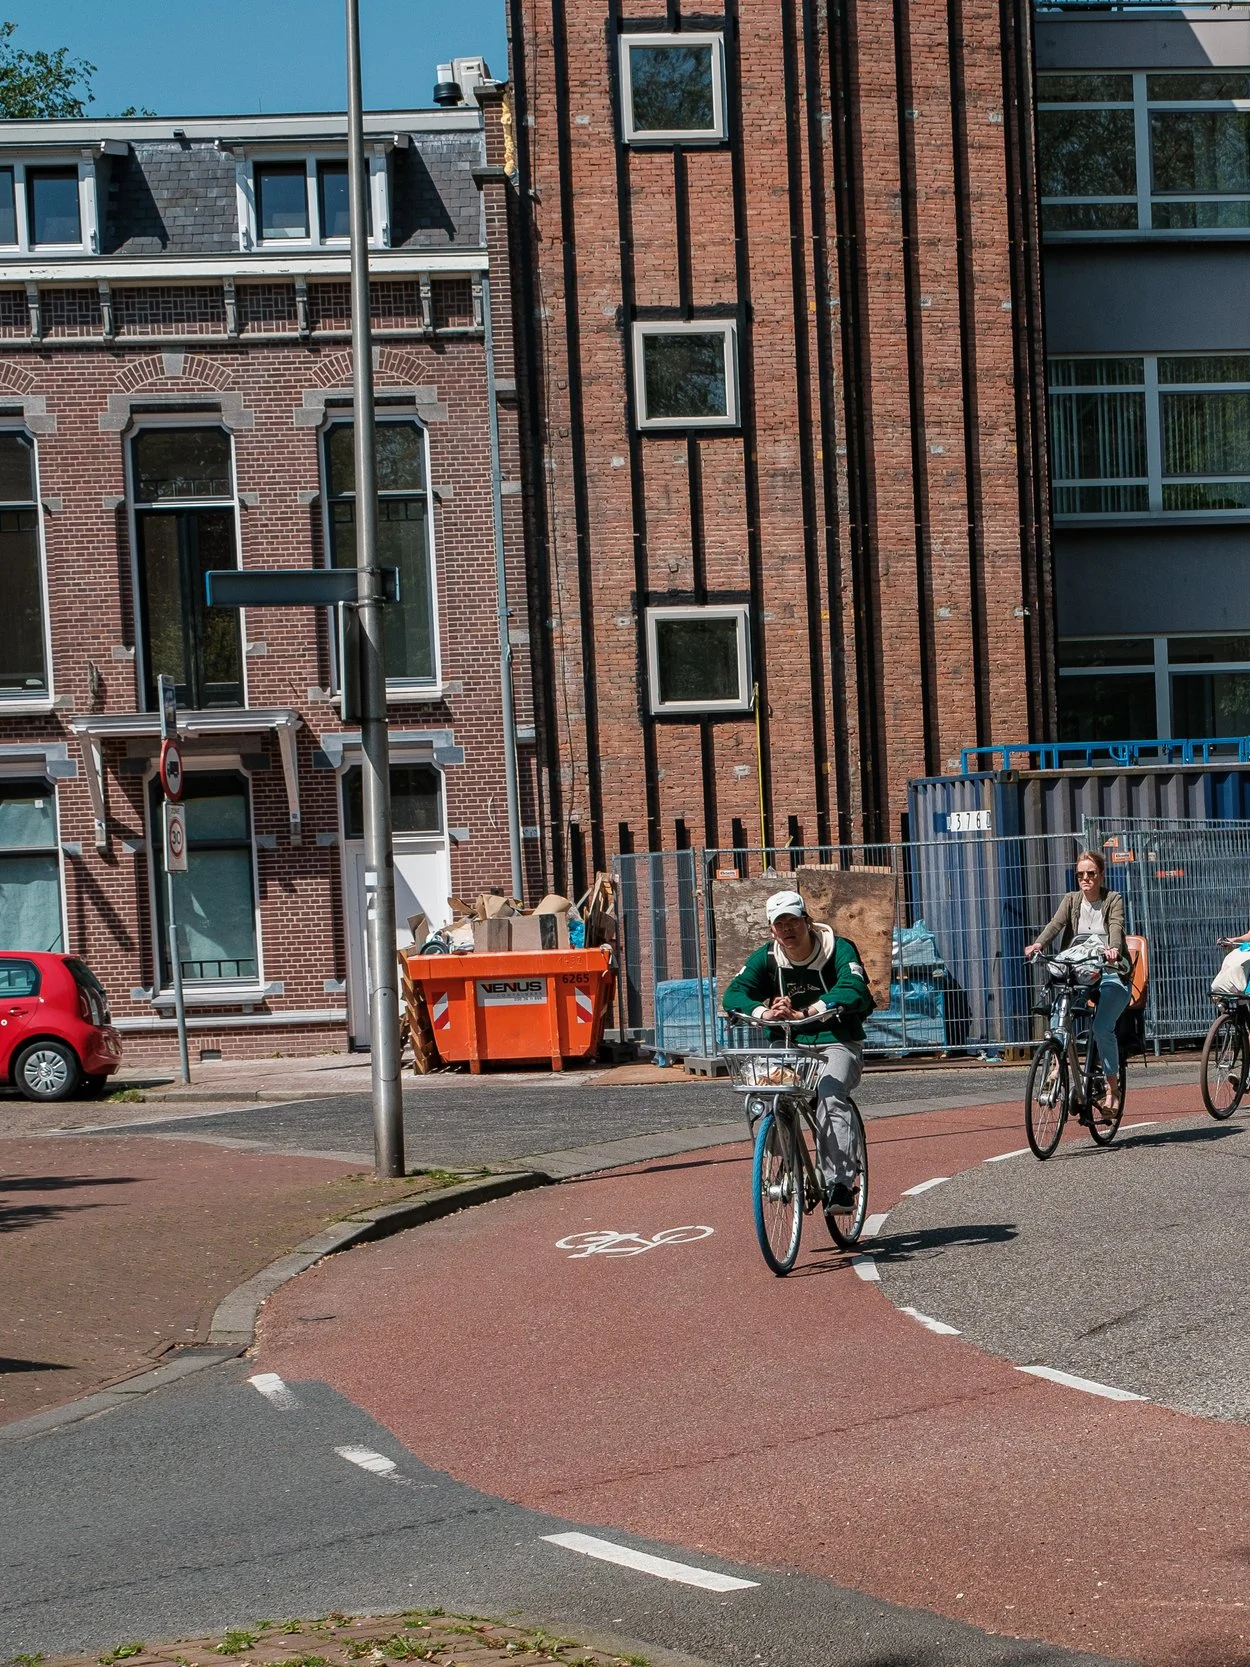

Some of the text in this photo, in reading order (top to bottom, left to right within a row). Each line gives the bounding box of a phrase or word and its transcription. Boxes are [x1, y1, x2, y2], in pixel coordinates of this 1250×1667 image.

[171, 830, 181, 845] 30
[562, 973, 590, 984] 6265
[481, 981, 542, 994] VENUS
